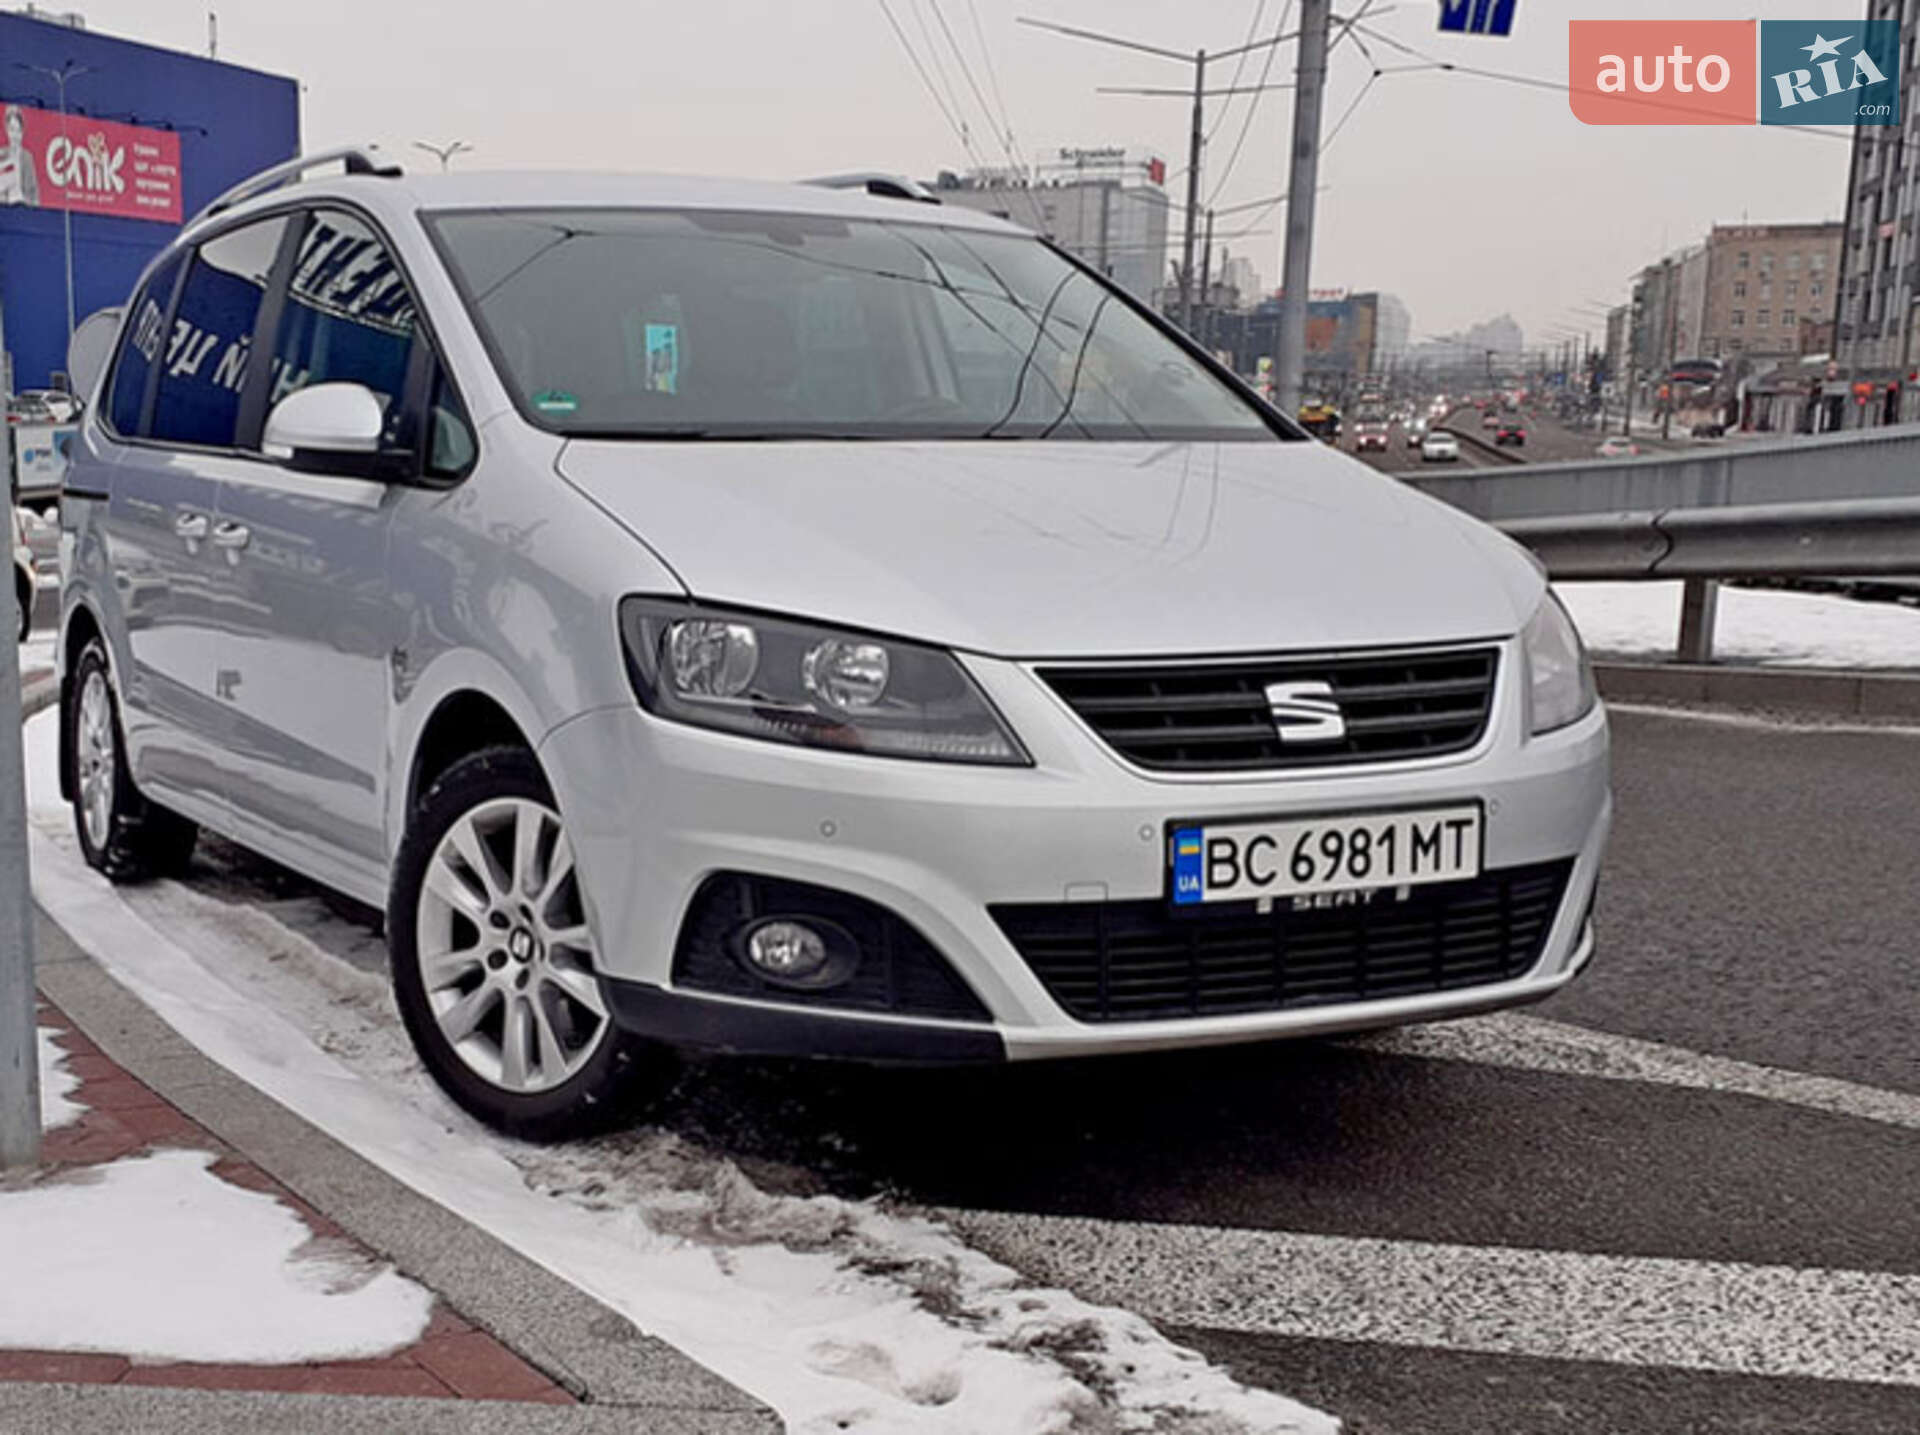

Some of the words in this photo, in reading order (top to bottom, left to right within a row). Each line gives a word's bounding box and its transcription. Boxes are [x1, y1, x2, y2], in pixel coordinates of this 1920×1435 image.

[1206, 834, 1278, 889] BC
[1290, 825, 1397, 883] 6981
[1410, 819, 1474, 873] MT
[1178, 875, 1200, 892] UA
